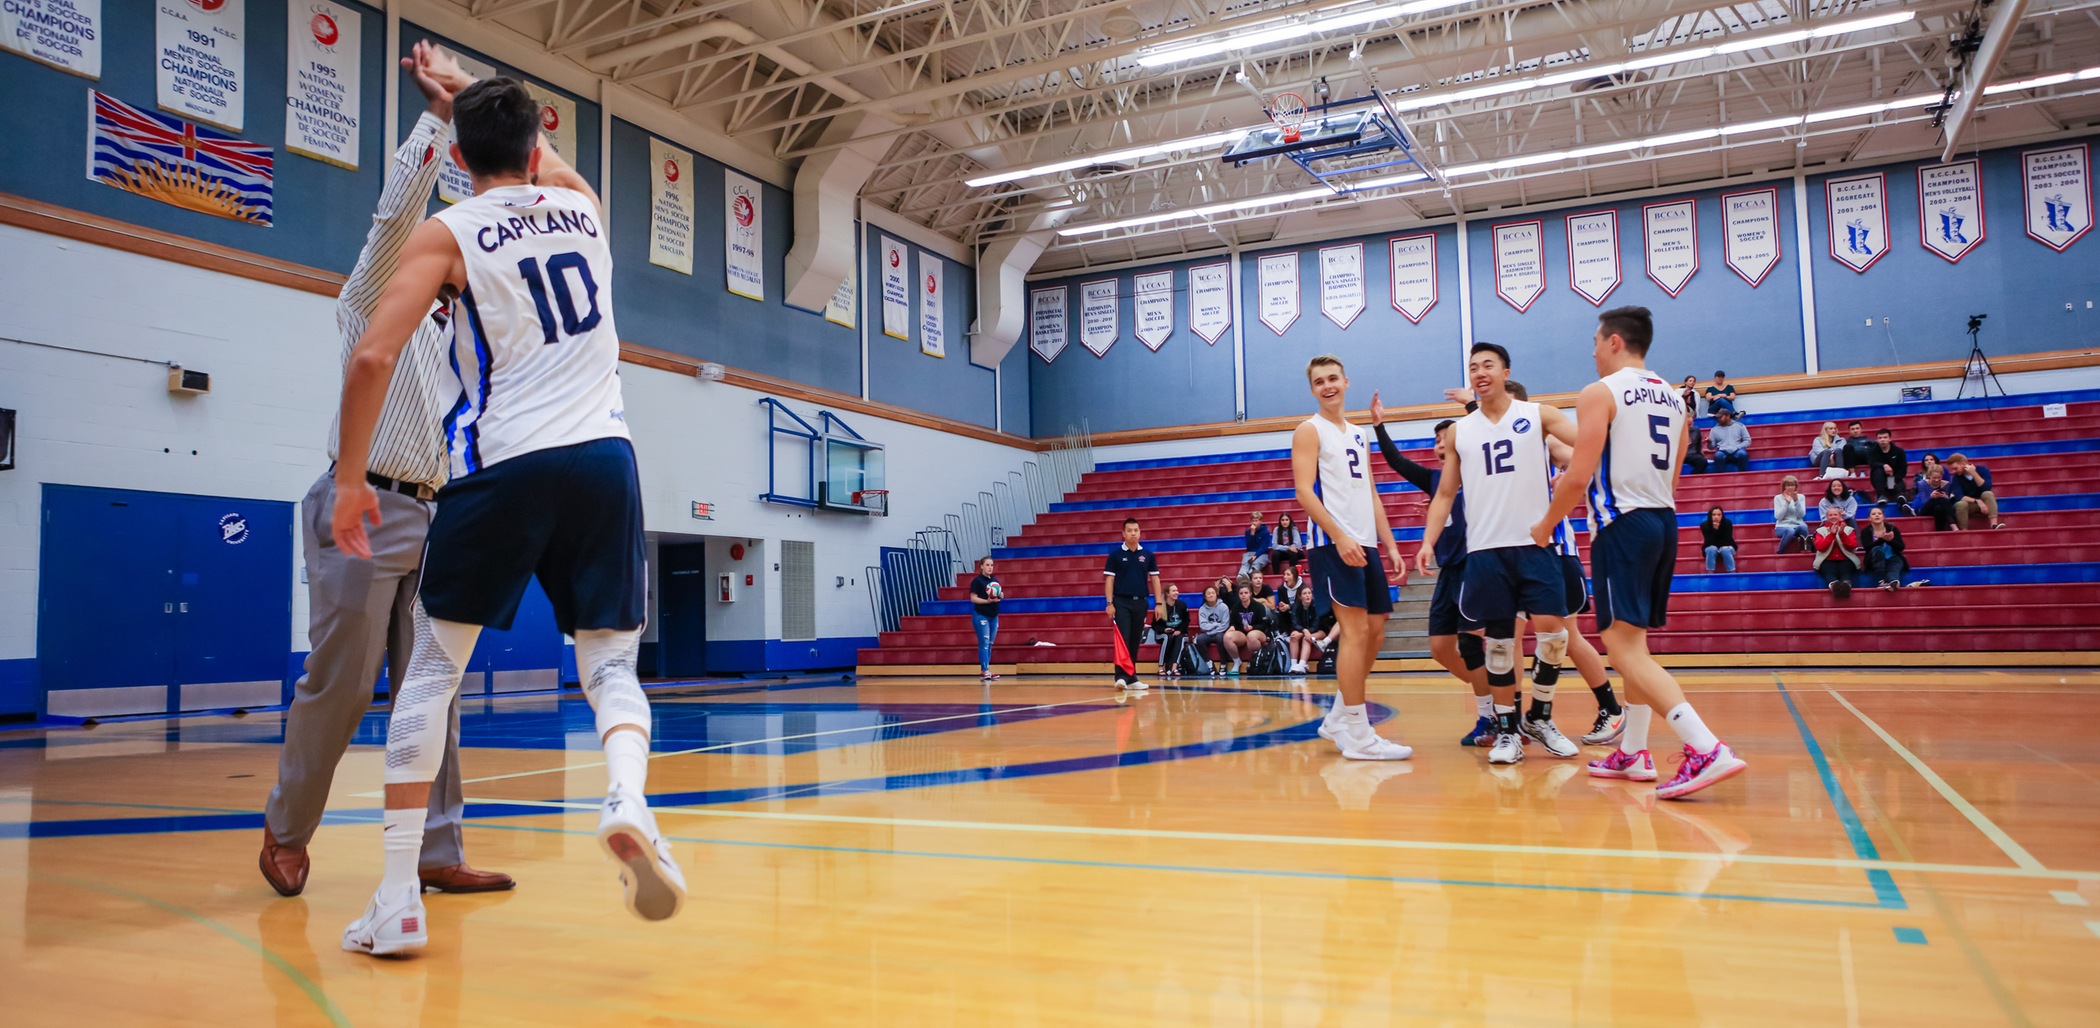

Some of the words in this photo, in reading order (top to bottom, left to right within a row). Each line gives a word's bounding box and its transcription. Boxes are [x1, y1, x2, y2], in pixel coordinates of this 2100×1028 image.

[4, 0, 95, 40] CHAMPIONS
[47, 4, 92, 26] SOCCER
[20, 20, 80, 45] NATIONAUX
[186, 29, 216, 48] 1991
[16, 28, 31, 40] DE
[37, 35, 83, 57] SOCCER
[164, 48, 193, 64] MEN'S
[198, 60, 236, 79] SOCCER
[178, 44, 222, 66] NATIONAL
[161, 58, 238, 92] CHAMPIONS
[310, 61, 336, 78] 1995
[175, 76, 225, 98] NATIONAUX
[299, 69, 346, 94] NATIONAL
[173, 84, 185, 95] DE
[190, 90, 227, 108] SOCCER
[299, 81, 344, 103] WOMEN'S
[305, 92, 340, 111] SOCCER
[286, 95, 357, 129] CHAMPIONS
[295, 112, 350, 137] NATIONAUX
[298, 121, 309, 133] DE
[312, 127, 347, 145] SOCCER
[2032, 160, 2078, 171] CHAMPIONS
[2053, 170, 2081, 178] SOCCER
[1928, 178, 1970, 187] CHAMPIONS
[1942, 186, 1975, 194] VOLLEYBALL
[665, 190, 680, 202] 1996
[1733, 200, 1766, 209] BCCAA
[1836, 193, 1875, 202] AGGREGATE
[658, 199, 684, 213] NATIONAL
[1654, 210, 1686, 219] BCCAA
[653, 212, 690, 232] CHAMPIONS
[671, 211, 690, 223] SOCCER
[1577, 222, 1607, 231] BCCAA
[1732, 217, 1769, 225] CHAMPIONS
[477, 209, 598, 253] CAPILANO
[656, 224, 687, 239] NATIONAUX
[1503, 231, 1532, 241] BCCAA
[659, 243, 685, 257] MASCULIN
[666, 236, 685, 248] SOCCER
[1398, 244, 1426, 254] BCCAA
[1654, 245, 1690, 253] VOLLEYBALL
[1398, 261, 1429, 269] CHAMPIONS
[517, 251, 602, 345] 10
[1035, 328, 1063, 336] BASKETBALL
[1648, 414, 1670, 471] 5
[1346, 448, 1362, 478] 2
[1482, 439, 1515, 475] 12
